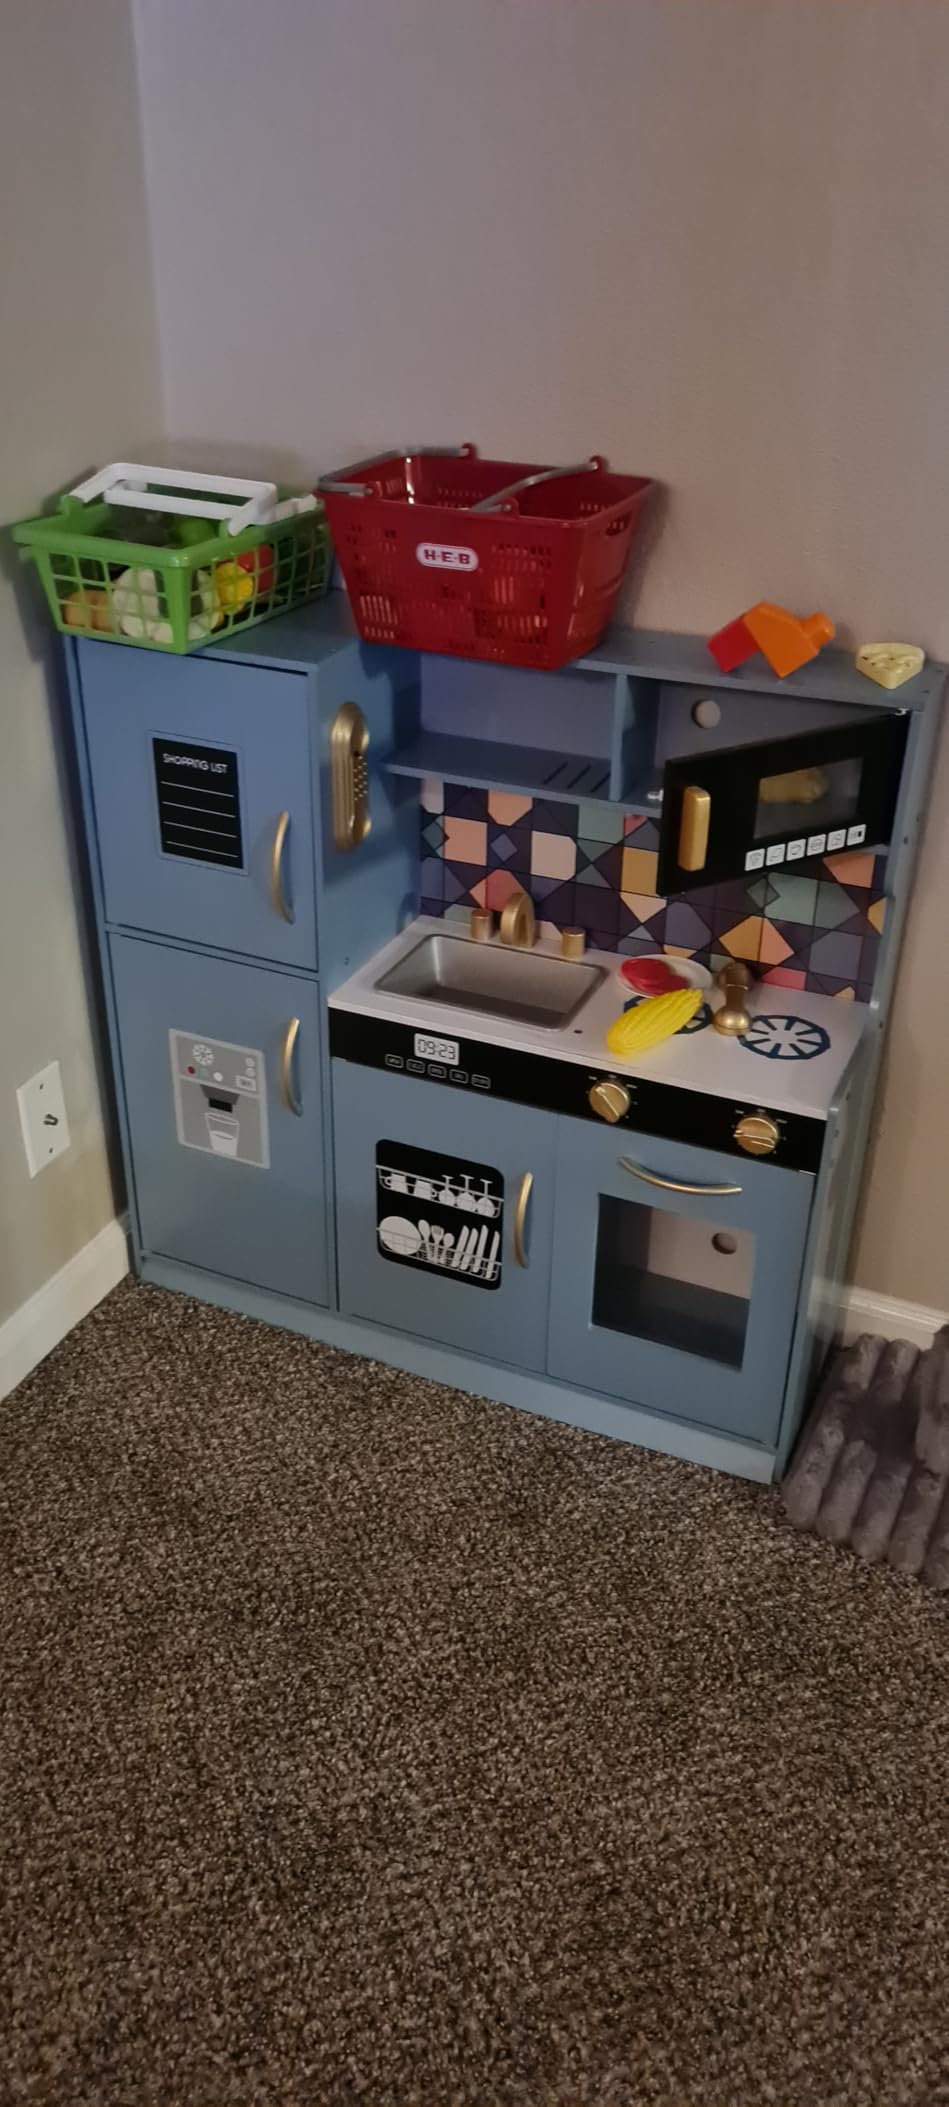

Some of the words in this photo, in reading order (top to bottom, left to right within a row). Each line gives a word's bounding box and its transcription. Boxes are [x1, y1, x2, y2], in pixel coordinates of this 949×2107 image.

[162, 752, 209, 771] SHOPPING
[210, 762, 228, 774] LIST
[417, 1039, 456, 1060] 09:23
